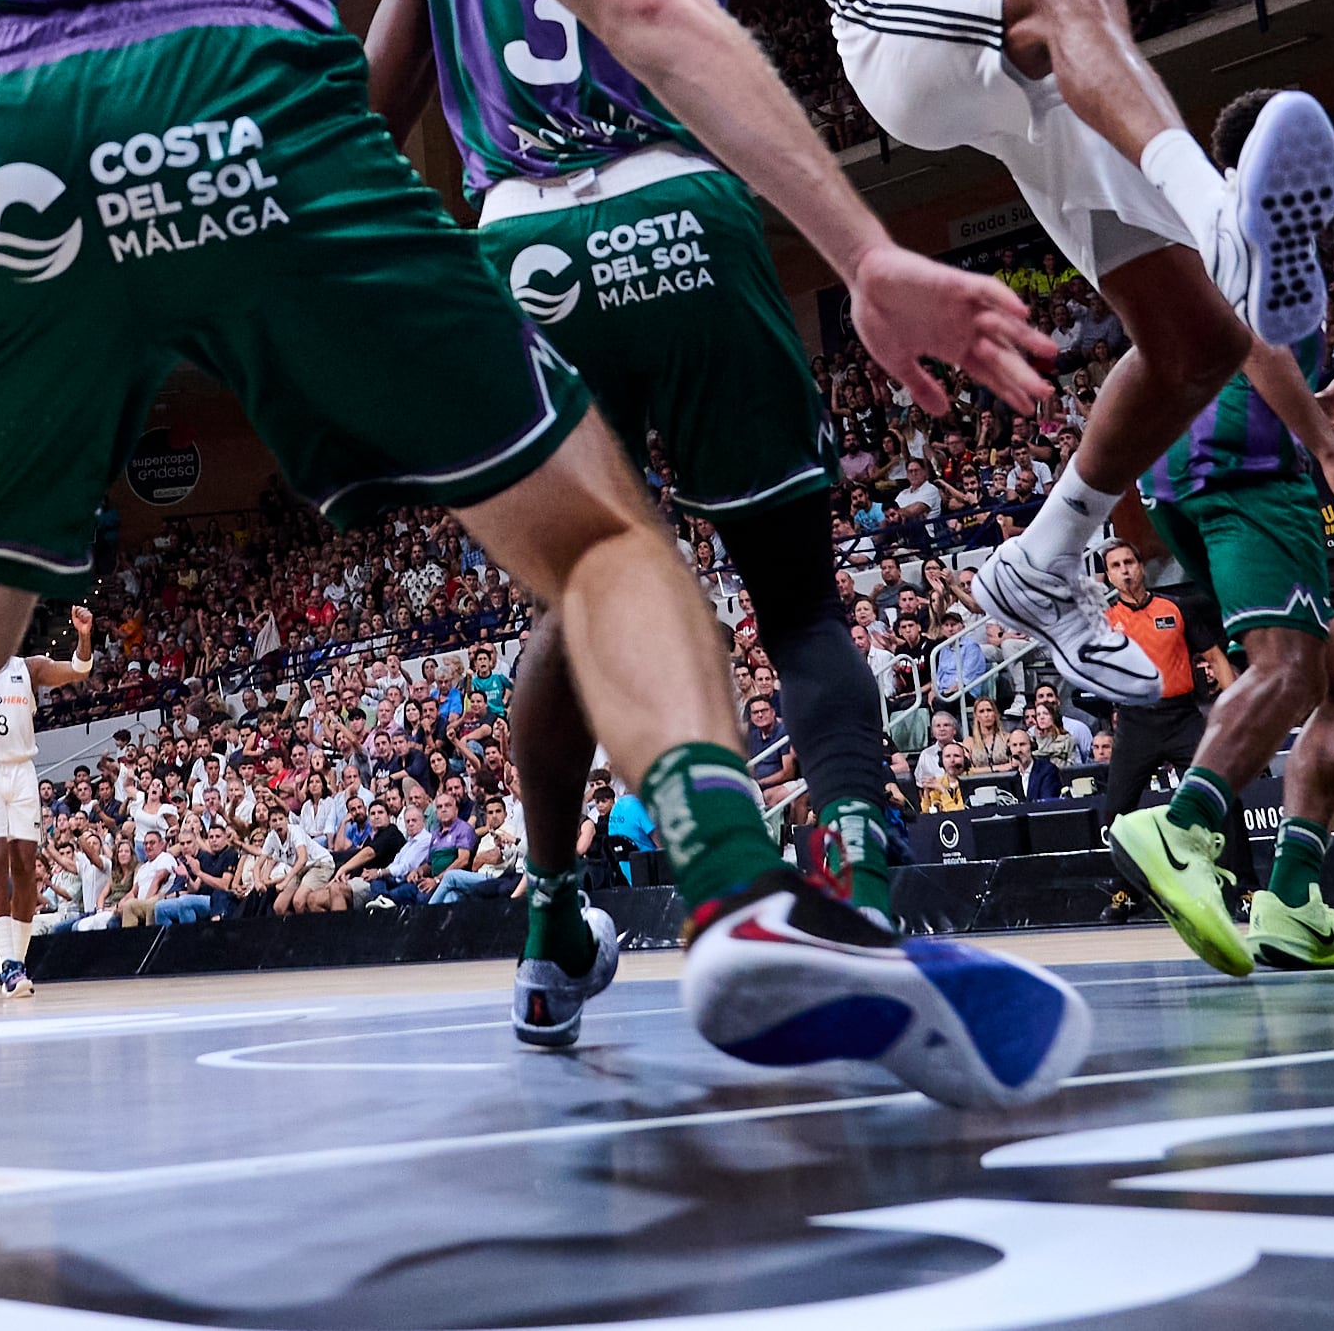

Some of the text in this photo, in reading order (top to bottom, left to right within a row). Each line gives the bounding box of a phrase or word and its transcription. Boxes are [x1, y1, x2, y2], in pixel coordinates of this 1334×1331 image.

[89, 115, 265, 185] COSTA
[96, 157, 279, 228] DEL SOL
[107, 196, 291, 264] MÁLAGA
[586, 209, 705, 259] COSTA
[960, 213, 1007, 238] Grada
[590, 239, 711, 287] DEL SOL
[597, 267, 715, 311] MÁLAGA
[131, 453, 195, 469] supercopa
[138, 465, 196, 481] endesa
